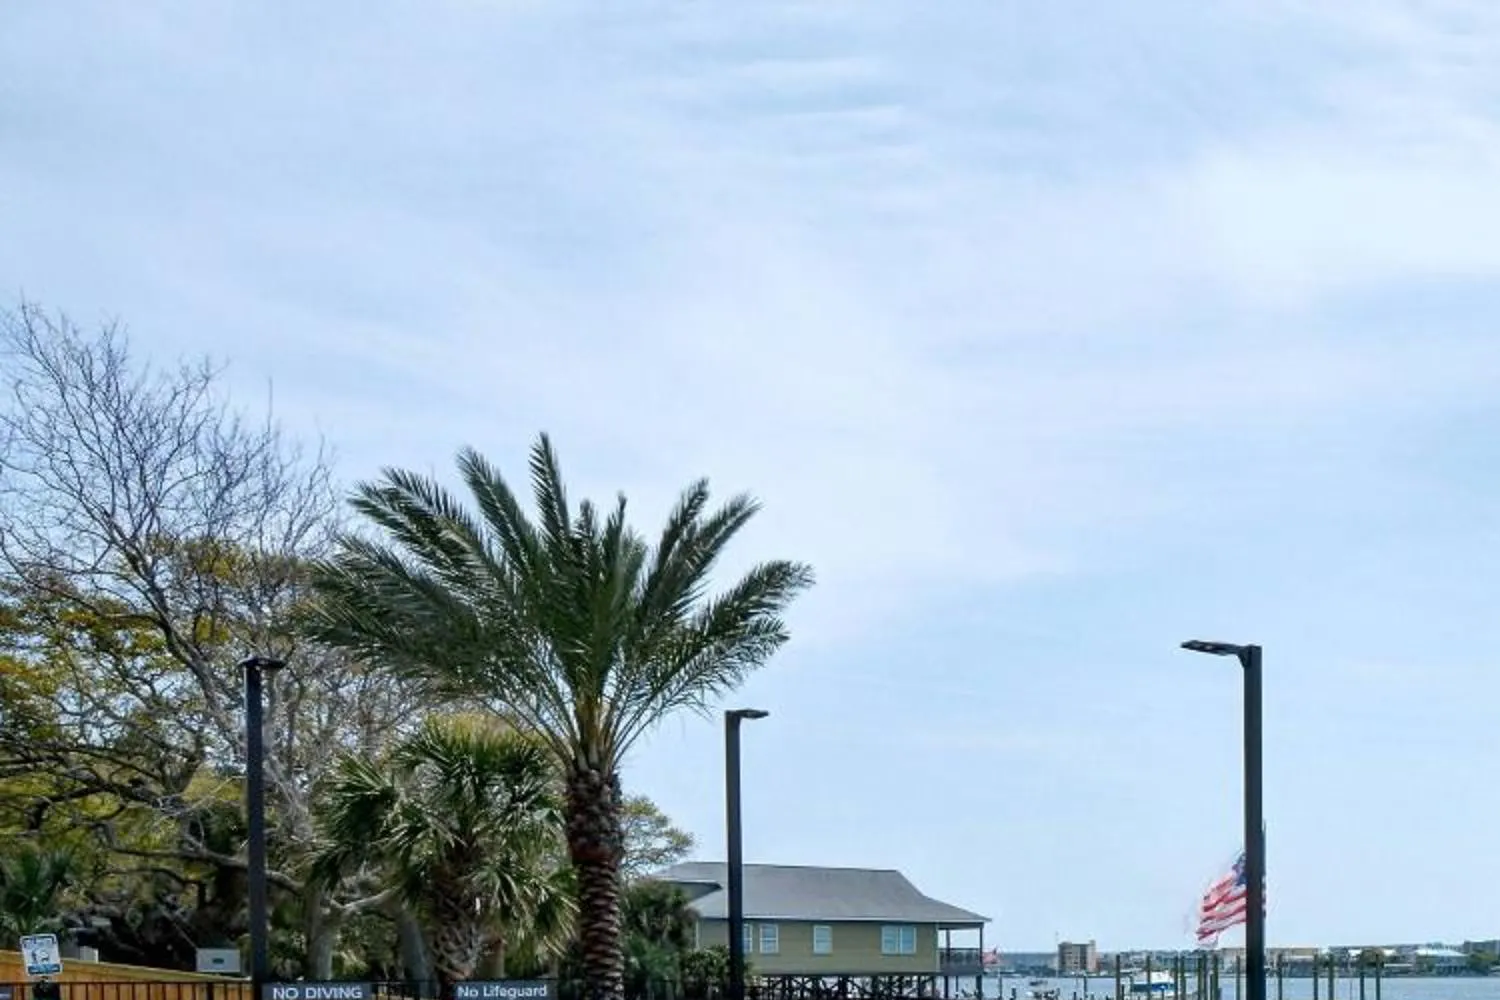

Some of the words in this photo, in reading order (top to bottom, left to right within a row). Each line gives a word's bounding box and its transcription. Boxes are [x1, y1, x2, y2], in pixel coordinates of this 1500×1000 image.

[272, 987, 298, 999] NO
[305, 986, 362, 999] DIVING
[458, 986, 478, 998] No
[483, 984, 547, 998] Lifeguard
